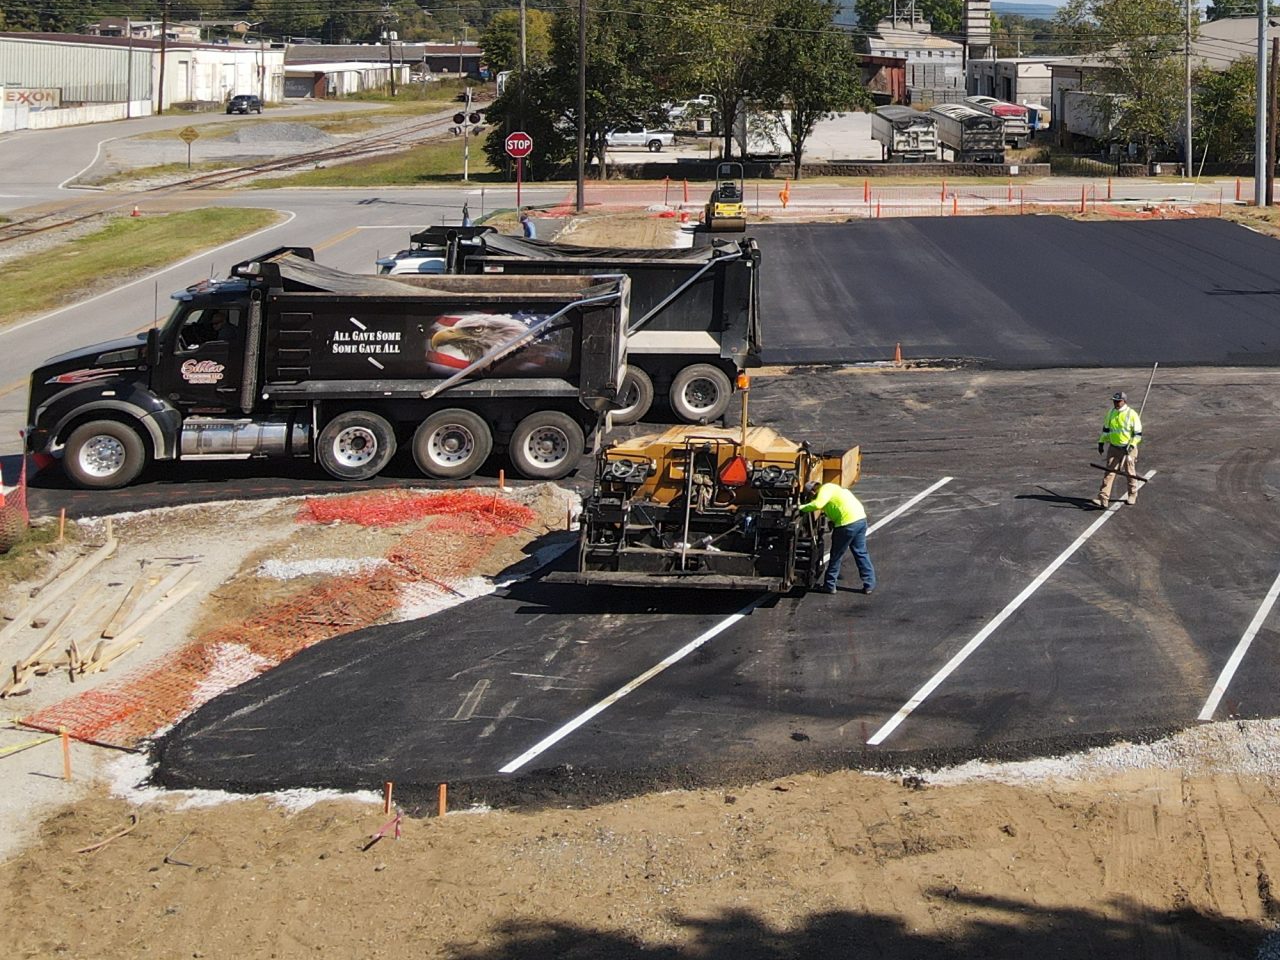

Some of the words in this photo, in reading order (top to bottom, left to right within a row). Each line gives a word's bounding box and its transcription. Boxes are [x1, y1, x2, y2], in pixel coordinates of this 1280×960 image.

[507, 140, 531, 150] STOP
[333, 330, 351, 341] ALL
[352, 330, 375, 341] GAVE
[376, 330, 401, 341] SOME
[332, 343, 358, 354] SOME
[358, 343, 382, 354] GAVE
[382, 342, 401, 354] ALL
